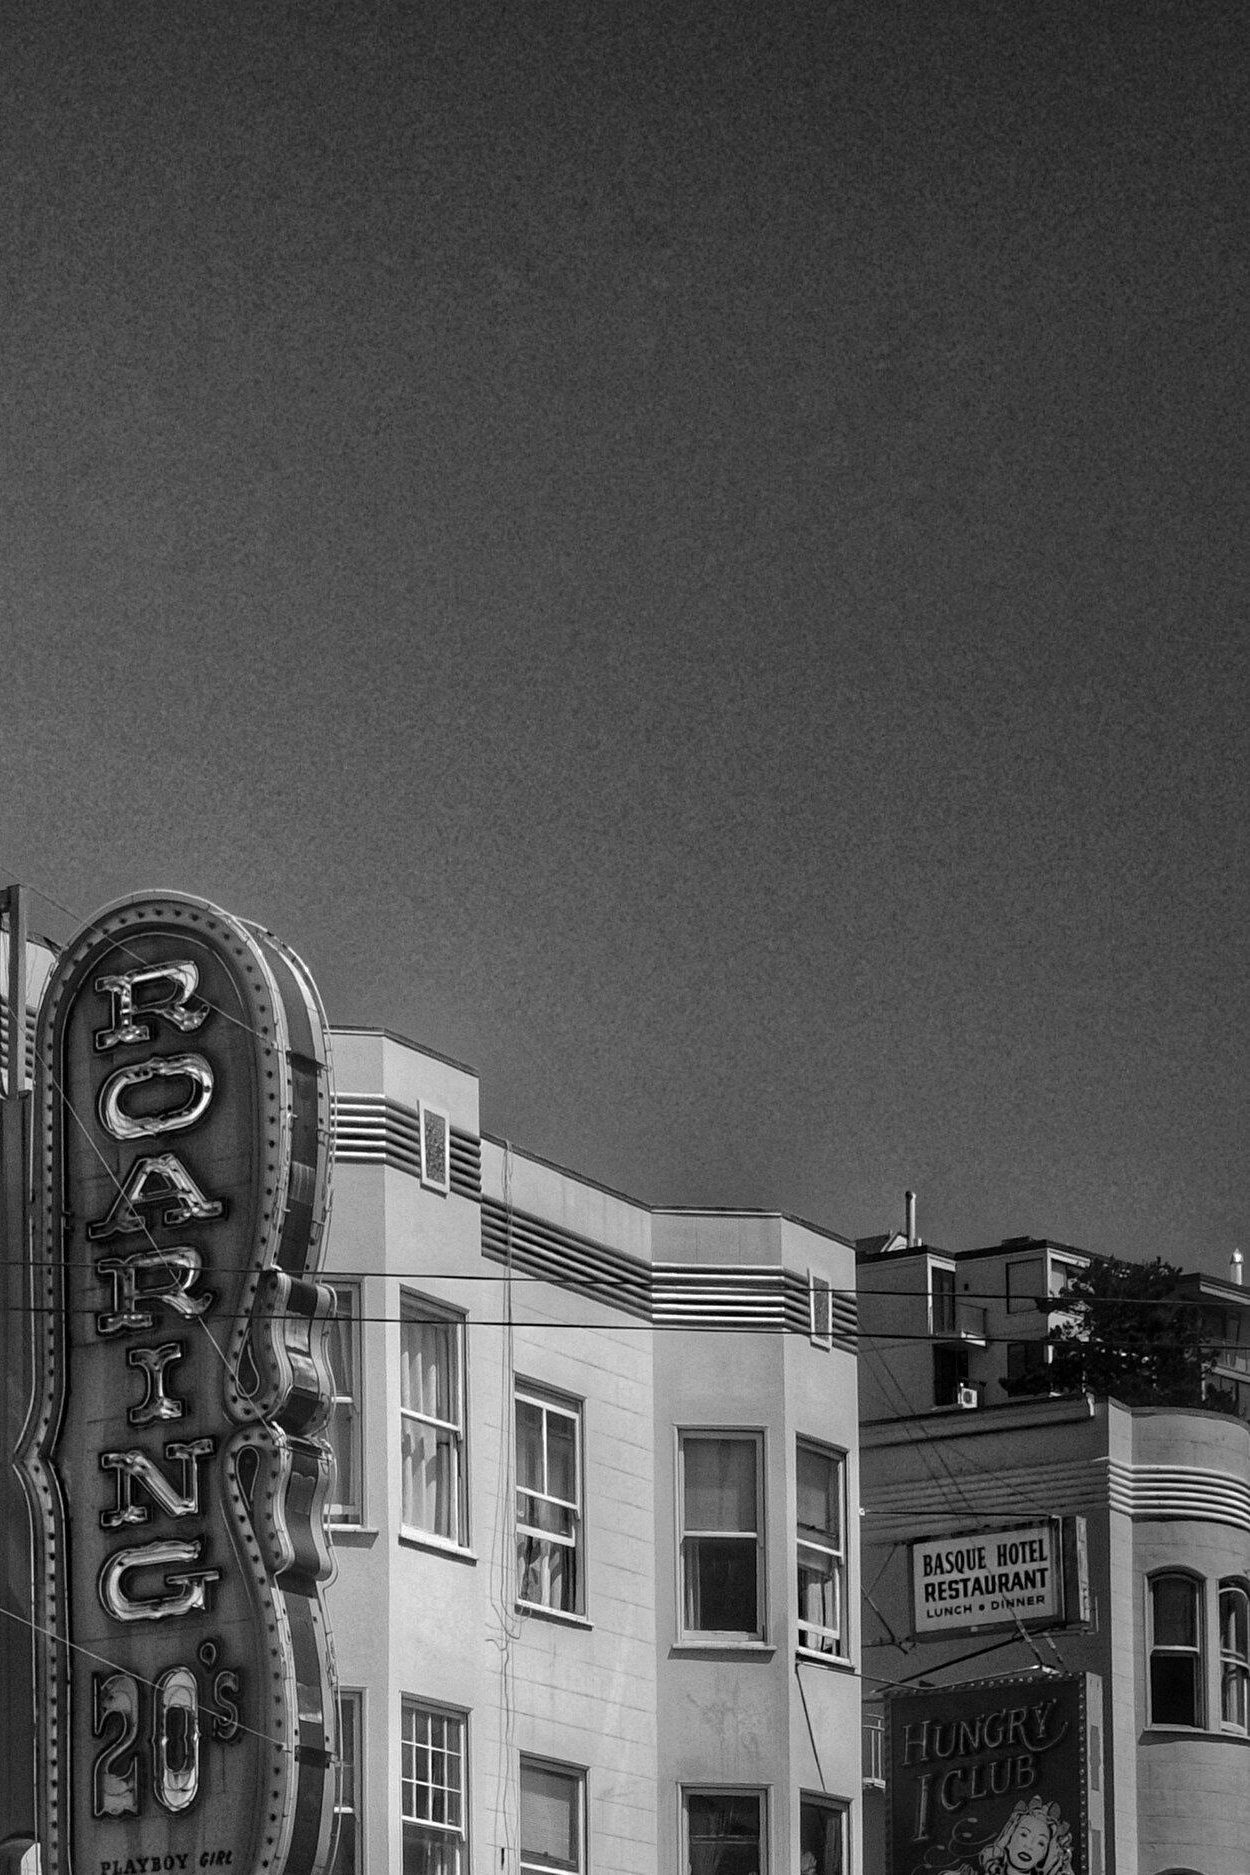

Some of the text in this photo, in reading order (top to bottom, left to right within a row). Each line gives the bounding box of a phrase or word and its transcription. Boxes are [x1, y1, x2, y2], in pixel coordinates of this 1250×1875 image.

[88, 959, 227, 1624] ROARING
[923, 1538, 1047, 1577] BASQUE HOTEL
[924, 1568, 1048, 1603] RESTAURANT
[926, 1595, 1045, 1618] LUNCH DINNER
[901, 1698, 1068, 1767] HUNGRY
[940, 1753, 1037, 1811] CLUB
[100, 1850, 233, 1875] PLAYBOY GIRL
